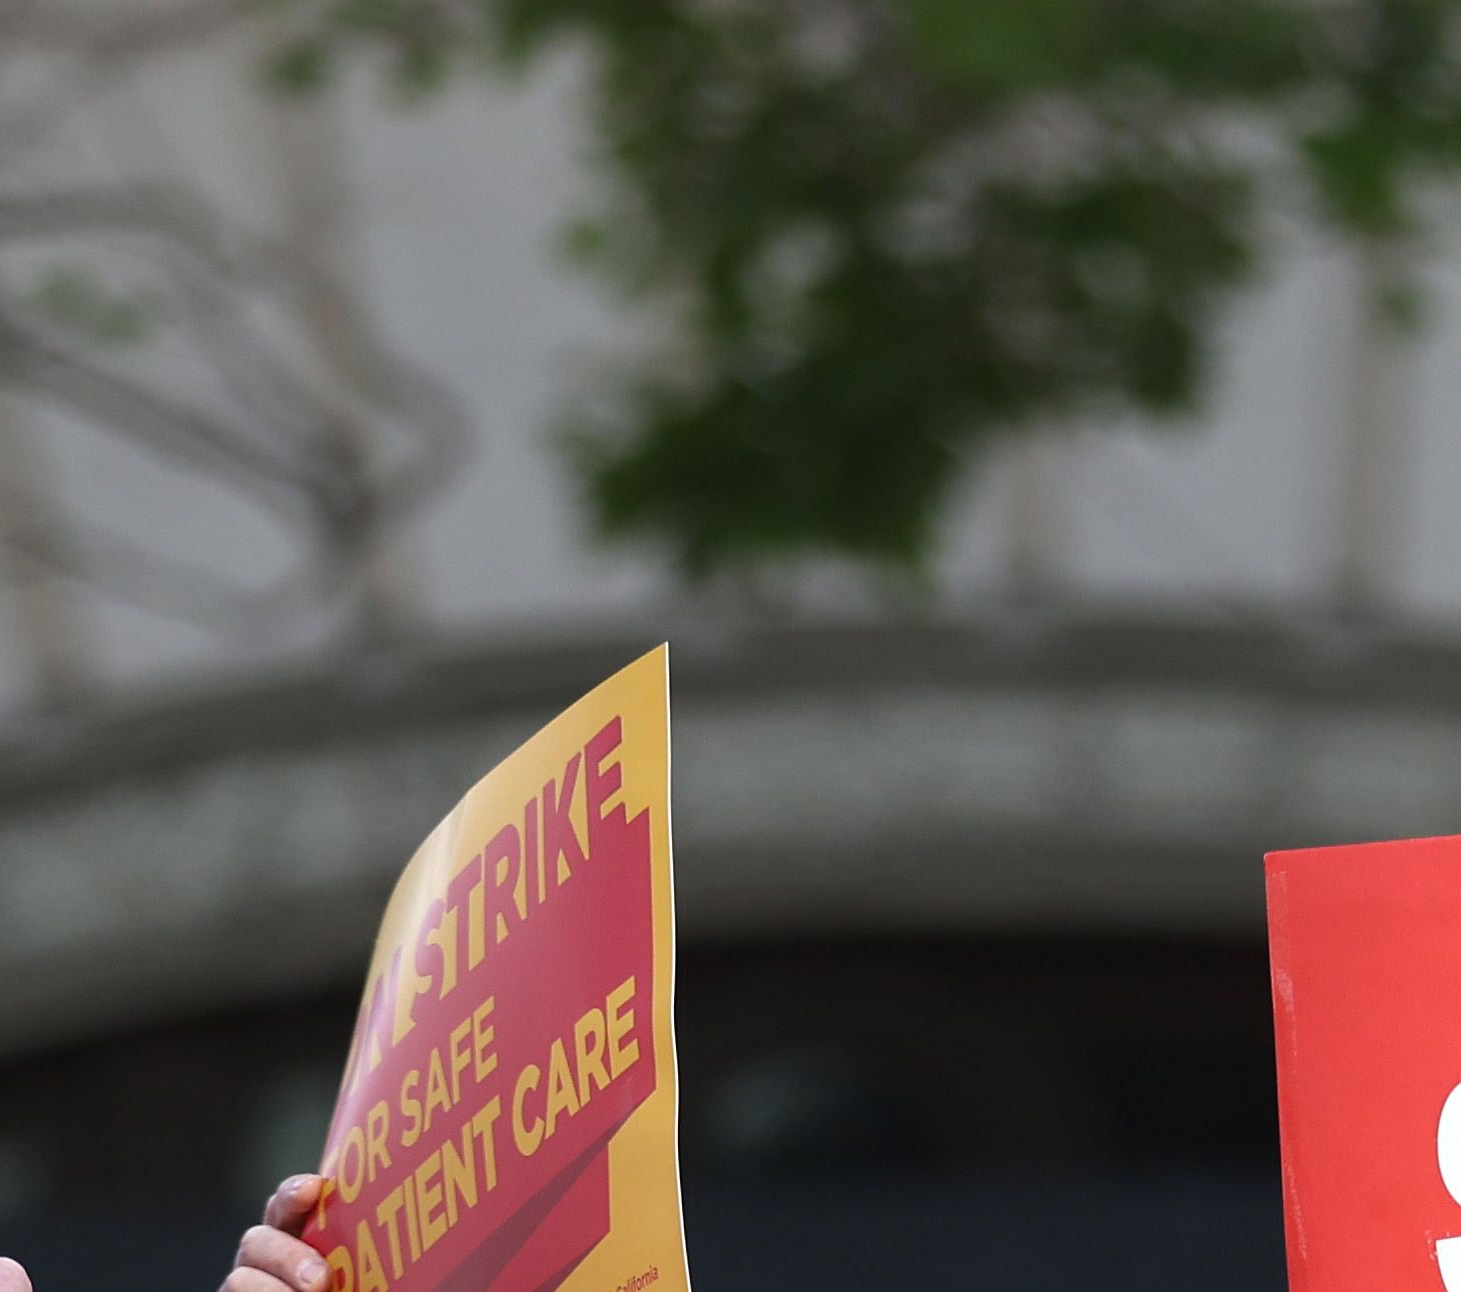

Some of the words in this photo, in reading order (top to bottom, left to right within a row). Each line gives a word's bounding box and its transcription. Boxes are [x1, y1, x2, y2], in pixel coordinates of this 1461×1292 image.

[412, 714, 624, 1022] STRIKE
[401, 996, 498, 1148] SAFE
[512, 975, 640, 1158] CARE
